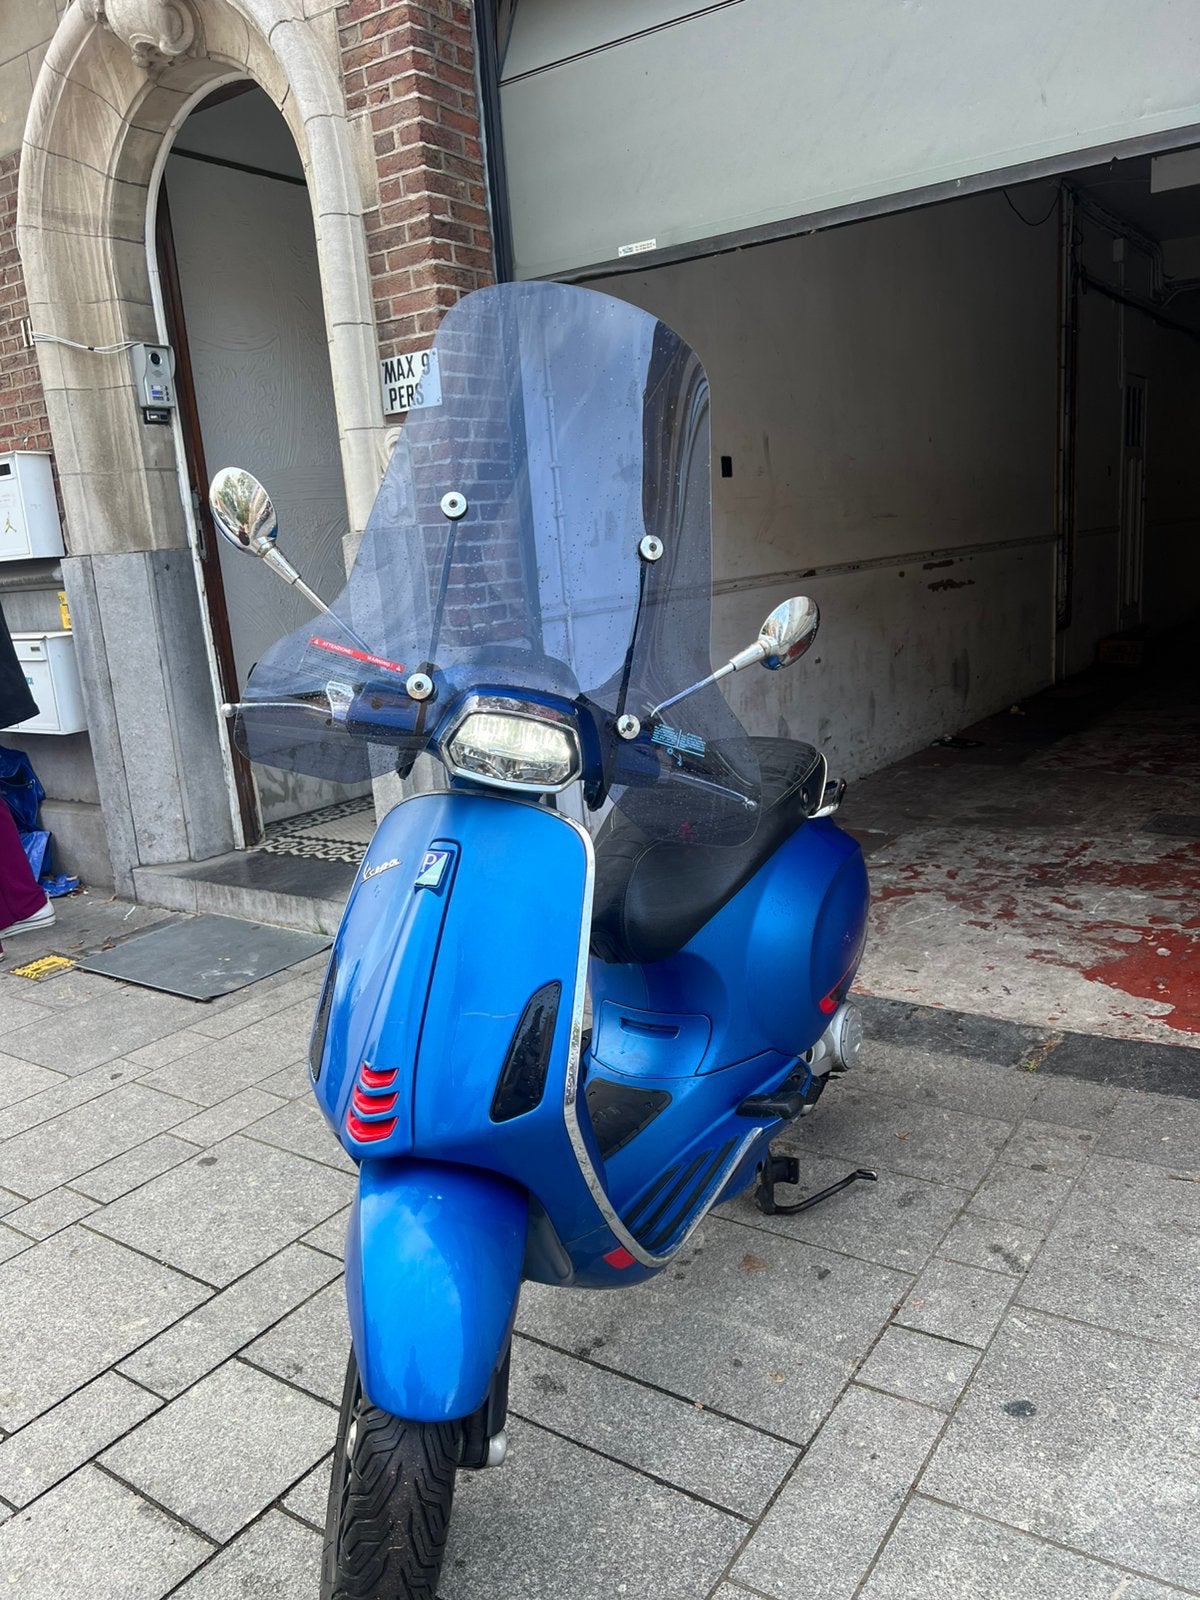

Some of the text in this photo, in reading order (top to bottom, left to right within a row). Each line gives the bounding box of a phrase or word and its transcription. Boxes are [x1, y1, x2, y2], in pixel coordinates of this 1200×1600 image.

[384, 352, 431, 384] MAX 9
[389, 383, 424, 410] PERS
[363, 858, 401, 881] Vespa
